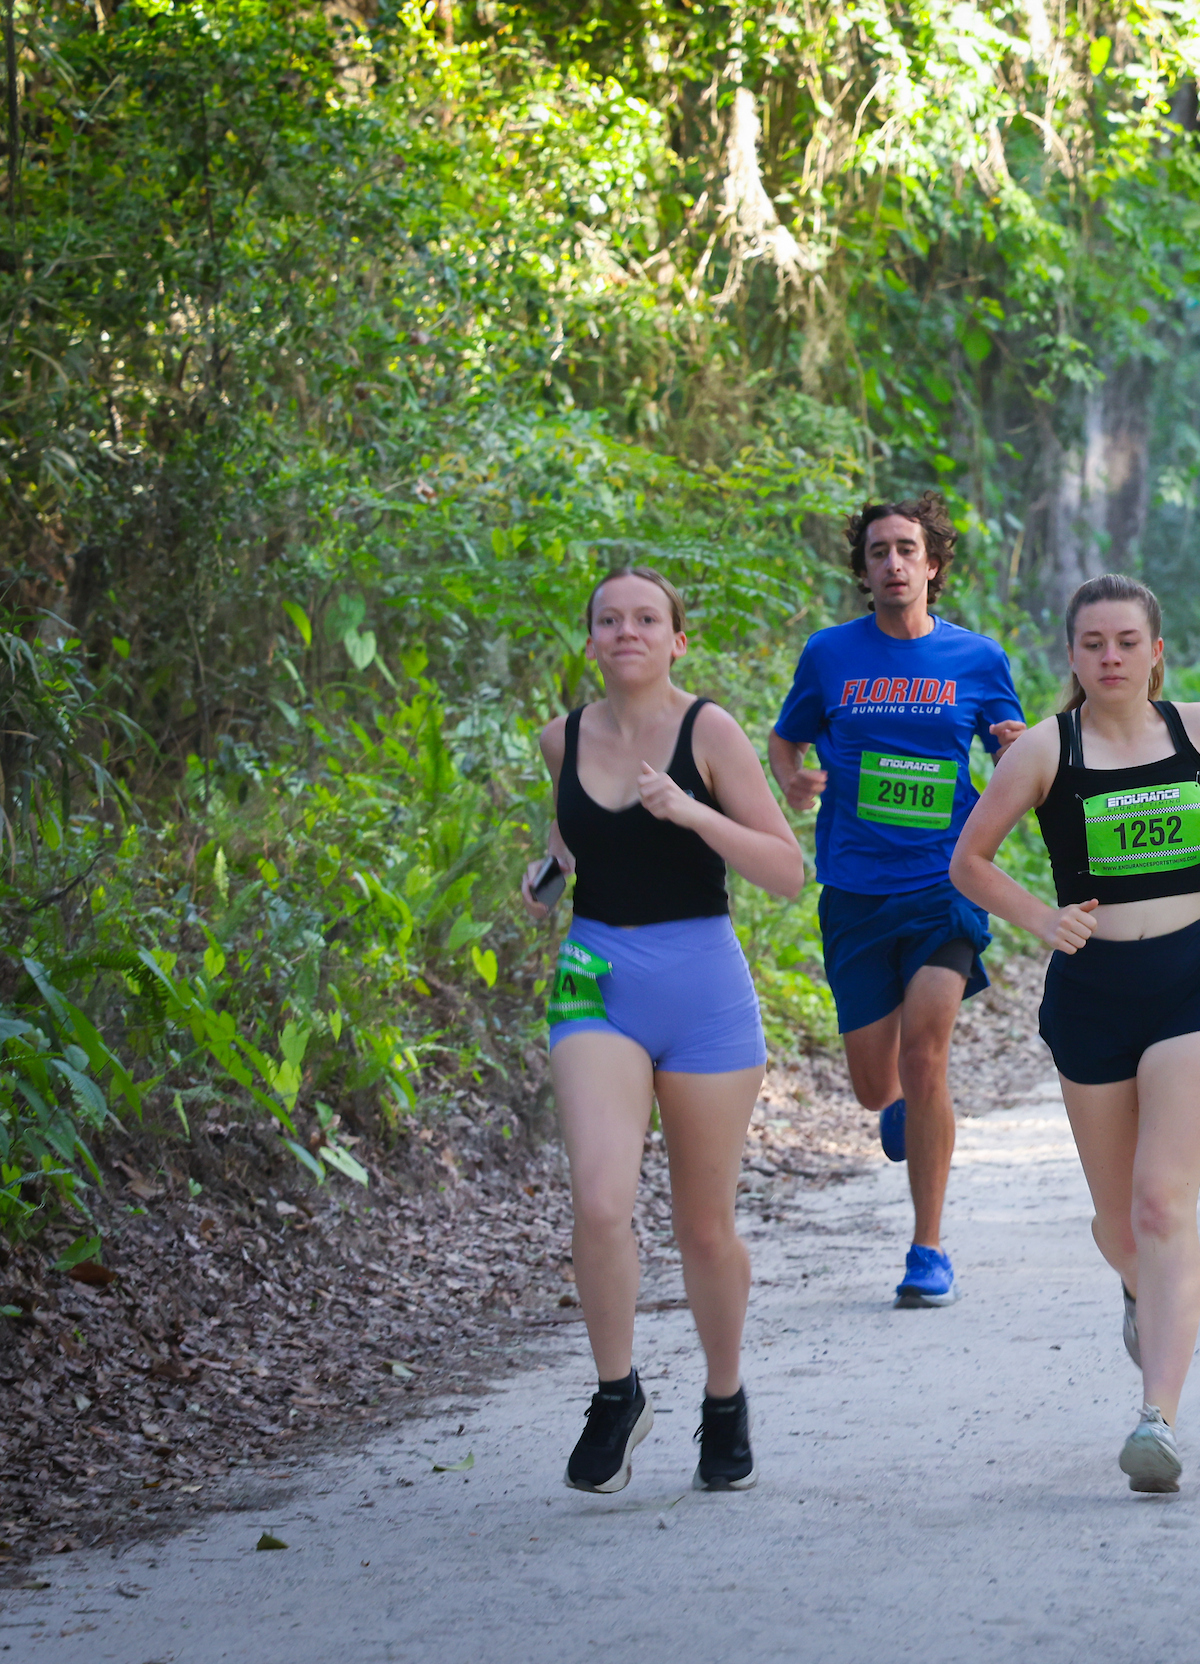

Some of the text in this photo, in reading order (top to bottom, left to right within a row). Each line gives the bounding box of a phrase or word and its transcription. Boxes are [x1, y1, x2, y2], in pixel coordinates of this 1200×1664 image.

[839, 677, 957, 706] FLORIDA
[851, 705, 942, 715] RUNNING CLUB
[879, 758, 940, 773] ENDURANCE
[878, 779, 935, 808] 2918
[1107, 788, 1180, 807] ENDURANCE
[1113, 815, 1183, 850] 1252
